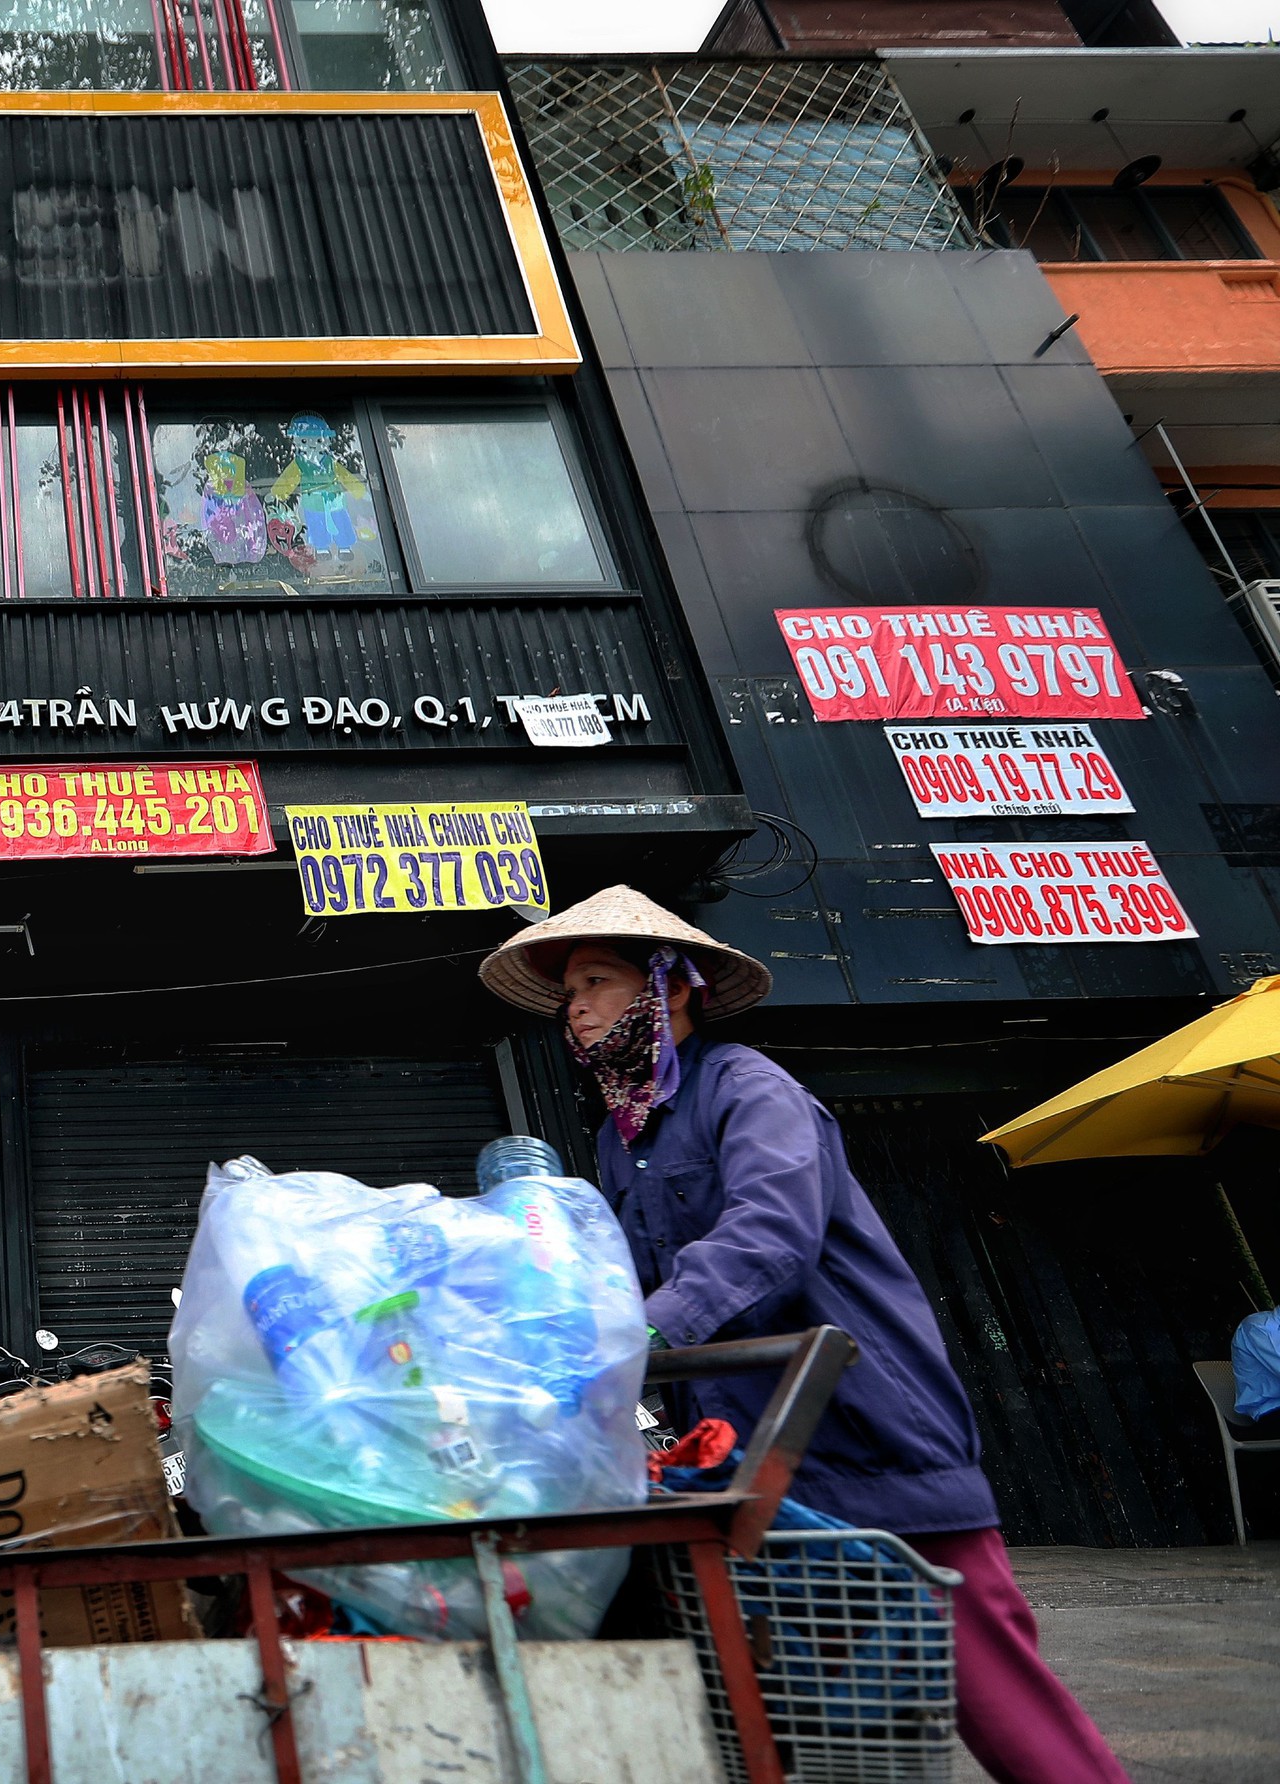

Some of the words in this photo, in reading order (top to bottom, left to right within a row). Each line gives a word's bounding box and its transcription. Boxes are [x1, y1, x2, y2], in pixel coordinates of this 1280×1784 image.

[782, 615, 872, 640] CHO
[882, 609, 997, 639] THUÊ
[1007, 611, 1107, 639] NHÀ
[795, 645, 890, 700] 091
[899, 643, 996, 697] 143
[997, 643, 1122, 697] 9797
[22, 685, 137, 728] TRẦN
[302, 696, 402, 734] ĐẠO,
[892, 732, 949, 750] CHO
[954, 727, 1027, 749] THUÊ
[1035, 727, 1094, 748] NHÀ
[59, 765, 158, 796] THUÊ
[169, 763, 252, 795] NHÀ
[901, 752, 1122, 804] 0909.19.77.29
[292, 816, 332, 850] CHO
[333, 807, 385, 849] THUÊ
[384, 807, 429, 848] NHÀ
[429, 806, 491, 846] CHÍNH
[491, 804, 533, 846] CHỦ
[992, 803, 1031, 816] (Chính
[90, 838, 149, 853] A.Long
[938, 847, 1007, 879] NHÀ
[1009, 852, 1074, 878] CHO
[1075, 846, 1160, 878] THUÊ
[300, 853, 397, 913] 0972
[399, 852, 467, 909] 377
[475, 848, 546, 905] 039
[953, 883, 1187, 937] 0908.875.399
